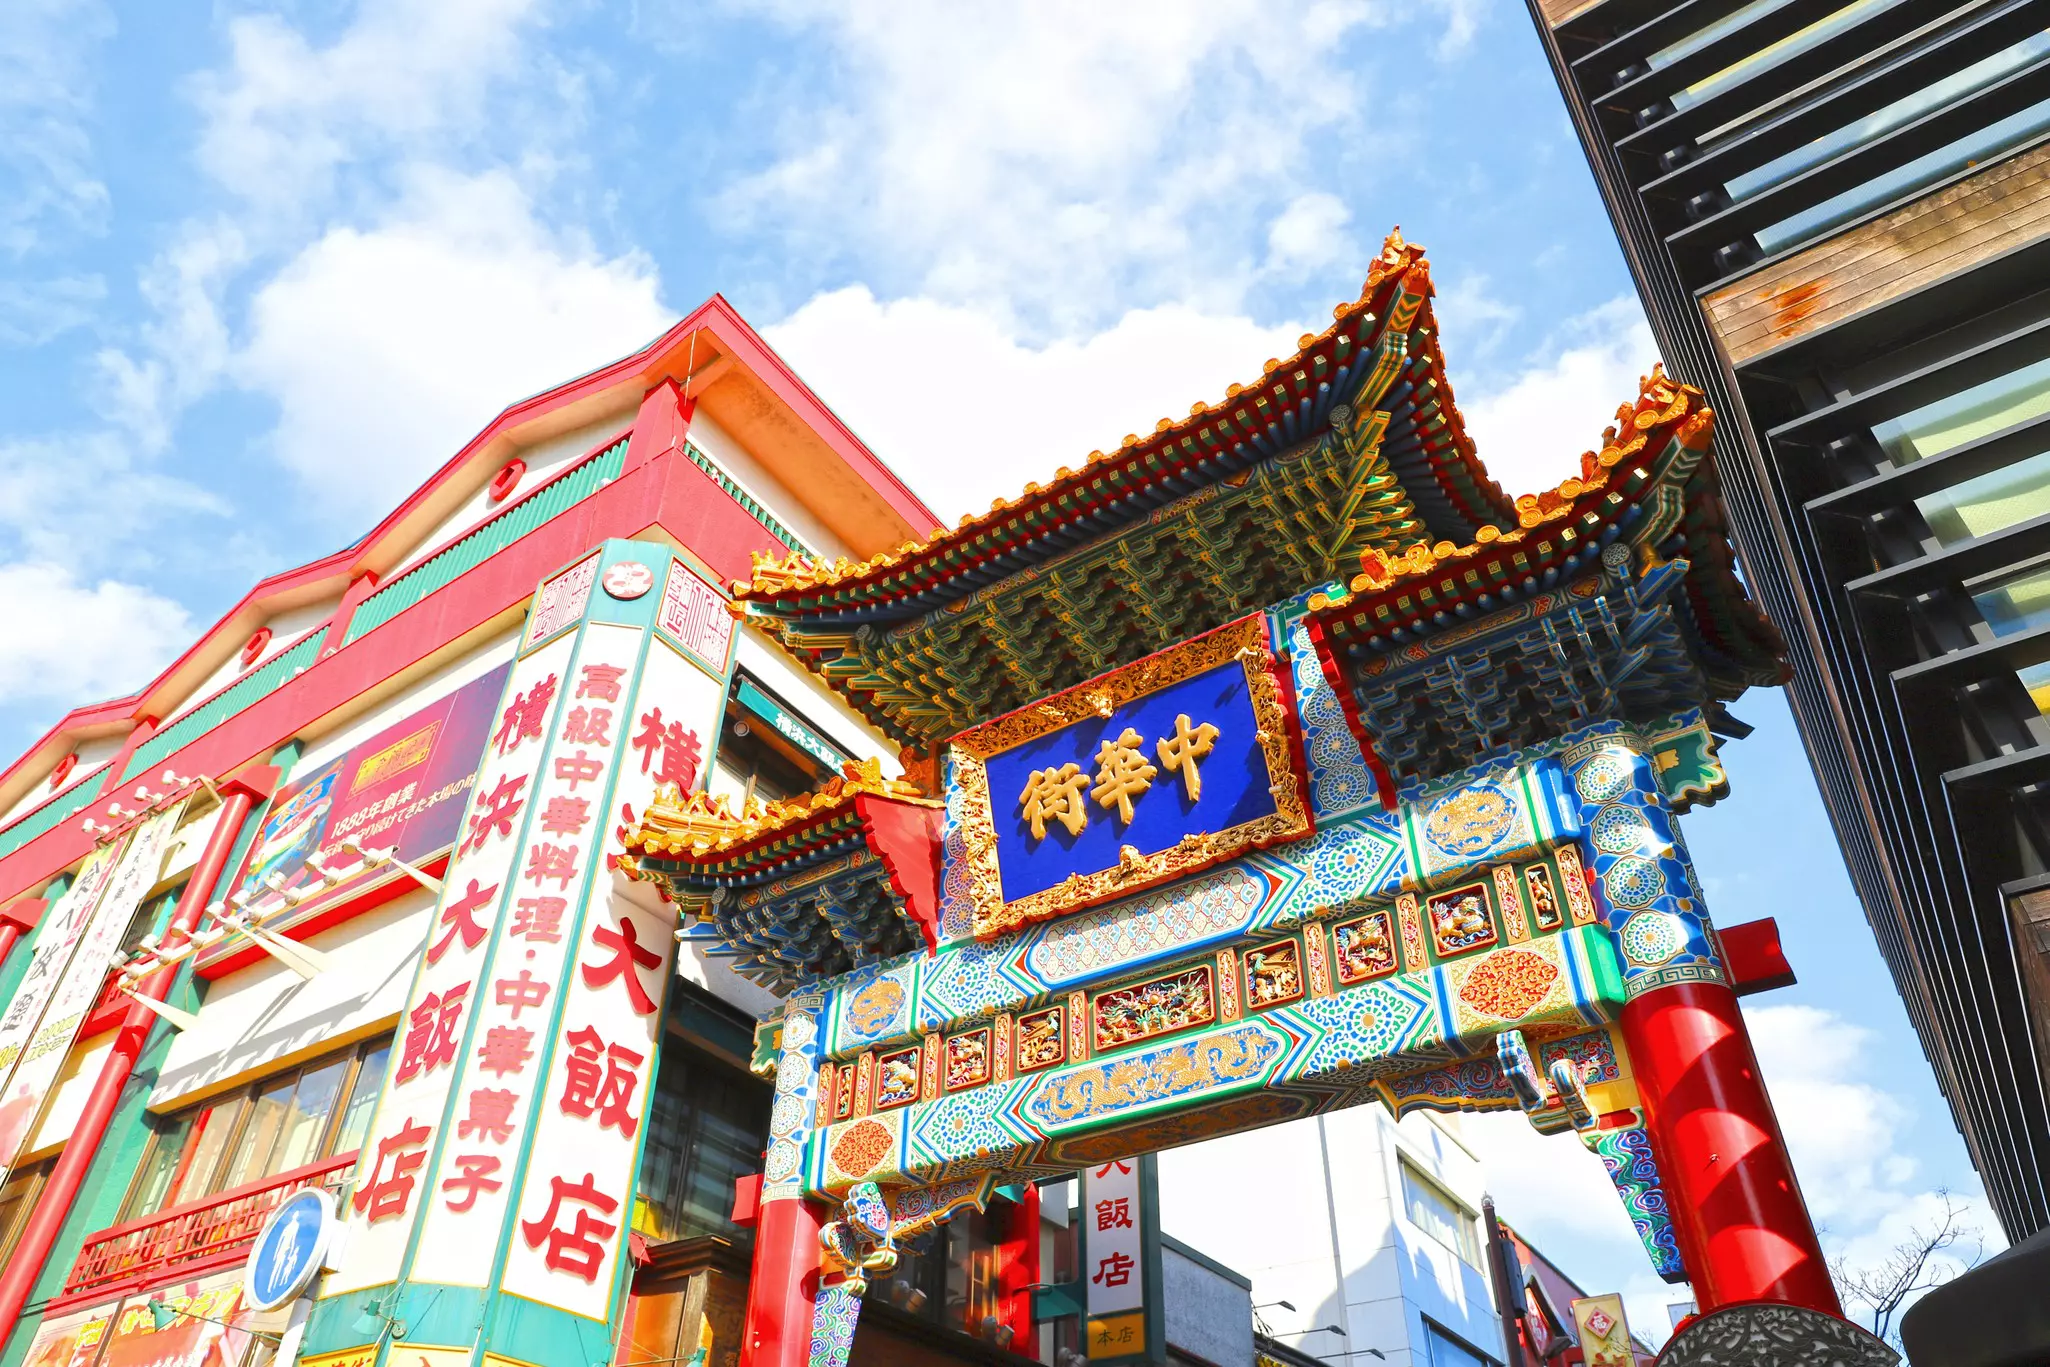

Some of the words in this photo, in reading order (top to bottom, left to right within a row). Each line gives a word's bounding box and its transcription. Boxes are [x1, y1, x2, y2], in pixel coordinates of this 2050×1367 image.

[330, 781, 417, 839] 1888年創業
[1019, 714, 1220, 841] 中華街
[353, 674, 558, 1223] 横浜大飯店
[522, 707, 702, 1284] 横大飯店
[1097, 1326, 1134, 1346] 本店
